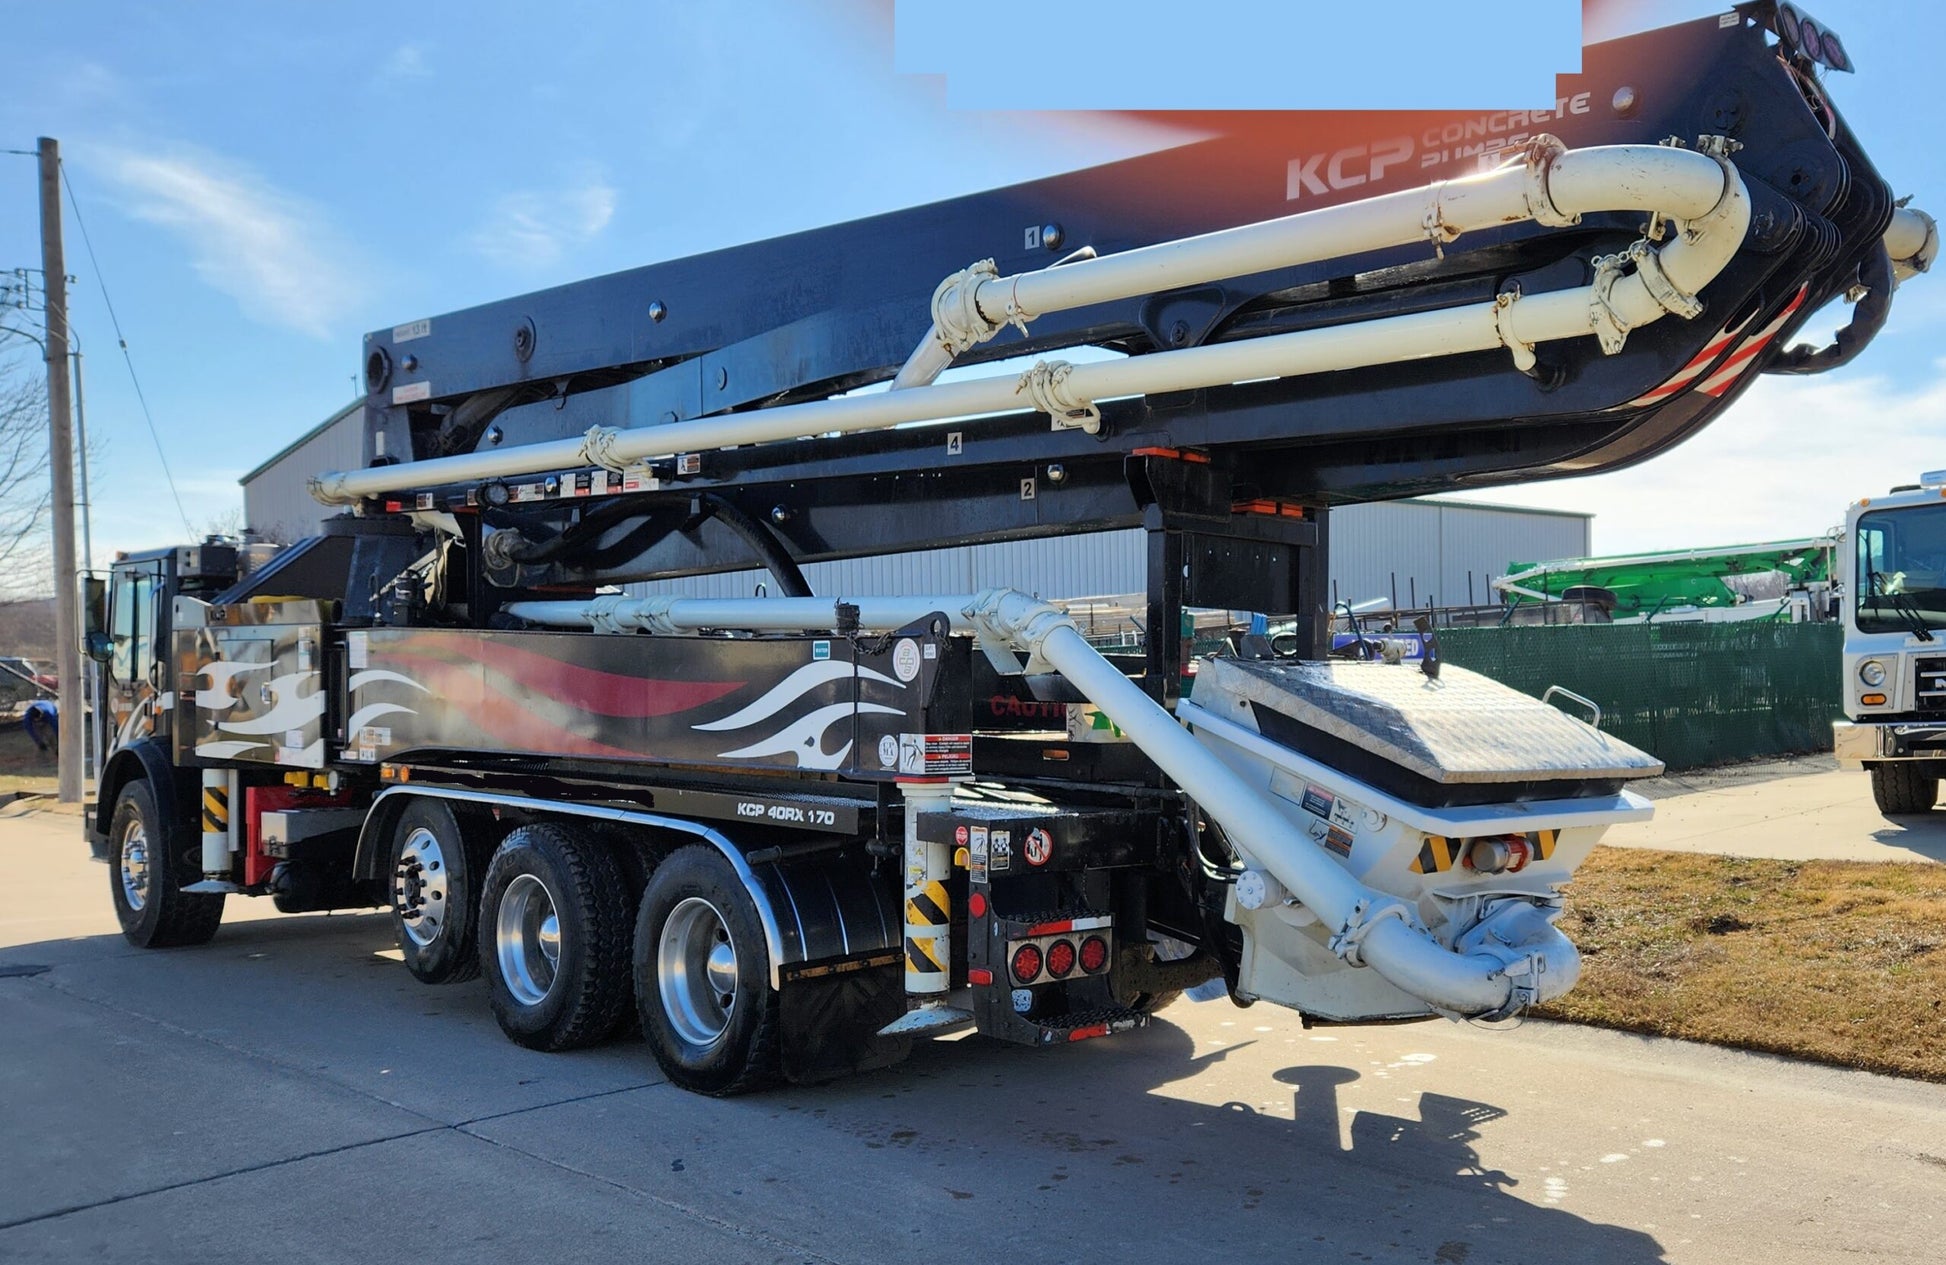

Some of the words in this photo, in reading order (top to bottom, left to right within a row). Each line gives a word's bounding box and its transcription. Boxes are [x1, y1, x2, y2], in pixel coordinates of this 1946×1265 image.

[1421, 92, 1591, 148] CONCRETE
[1286, 134, 1416, 201] KCP
[1028, 229, 1035, 247] 1
[950, 435, 960, 452] 4
[1023, 481, 1032, 497] 2
[737, 802, 765, 817] KCP
[767, 805, 805, 823] 40RX
[807, 809, 836, 826] 170
